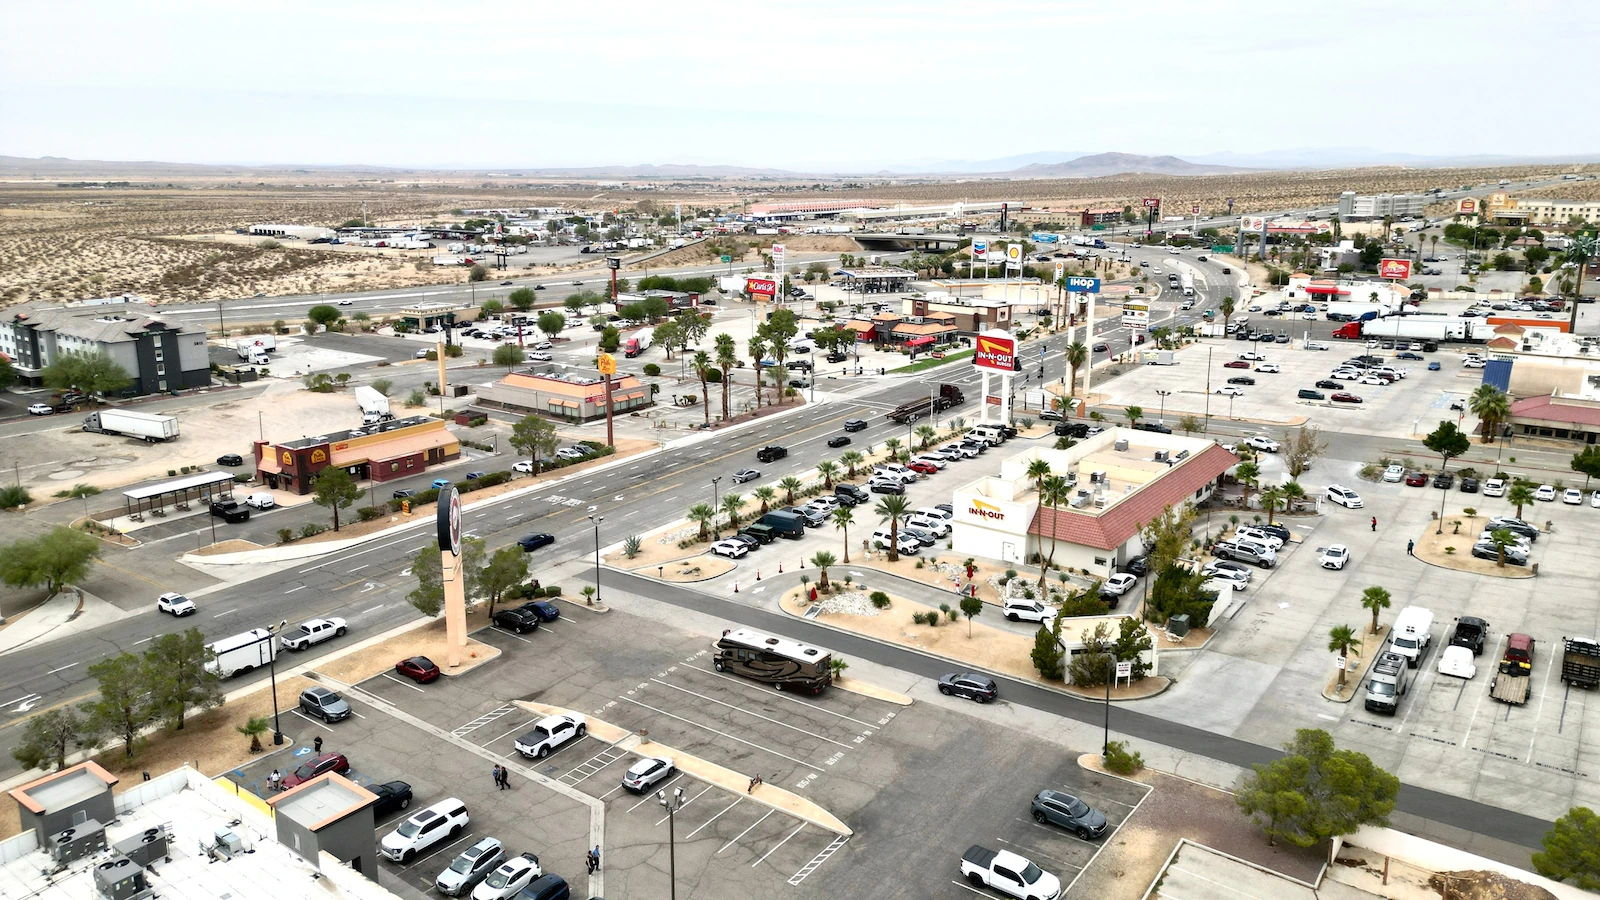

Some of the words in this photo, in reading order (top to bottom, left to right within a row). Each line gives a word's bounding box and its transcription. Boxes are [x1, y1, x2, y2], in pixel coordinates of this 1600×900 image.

[754, 282, 767, 290] Carl's
[1070, 279, 1094, 289] IHOP
[978, 351, 1012, 363] IN-N-OUT
[969, 507, 1004, 520] IN-N-OUT
